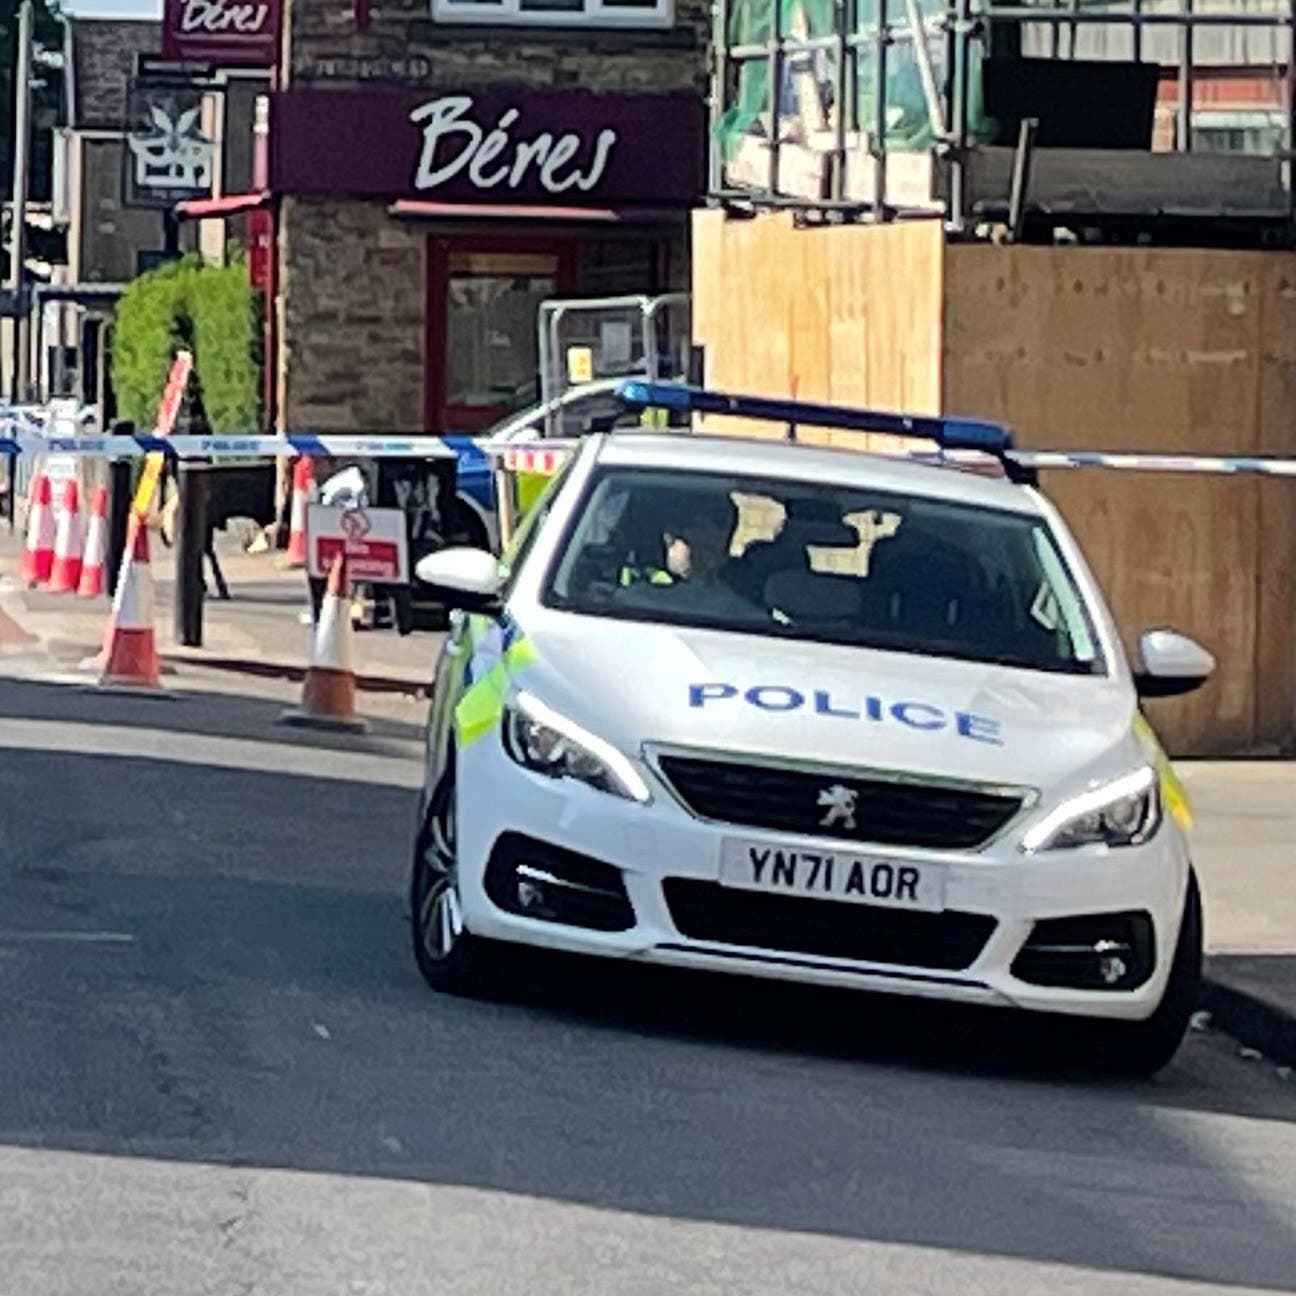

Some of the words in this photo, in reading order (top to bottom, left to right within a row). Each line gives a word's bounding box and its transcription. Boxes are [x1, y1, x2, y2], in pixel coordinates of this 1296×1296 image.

[409, 96, 617, 193] Béres
[689, 683, 1005, 746] POLICE
[749, 847, 835, 892] YN71
[845, 863, 920, 901] AOR
